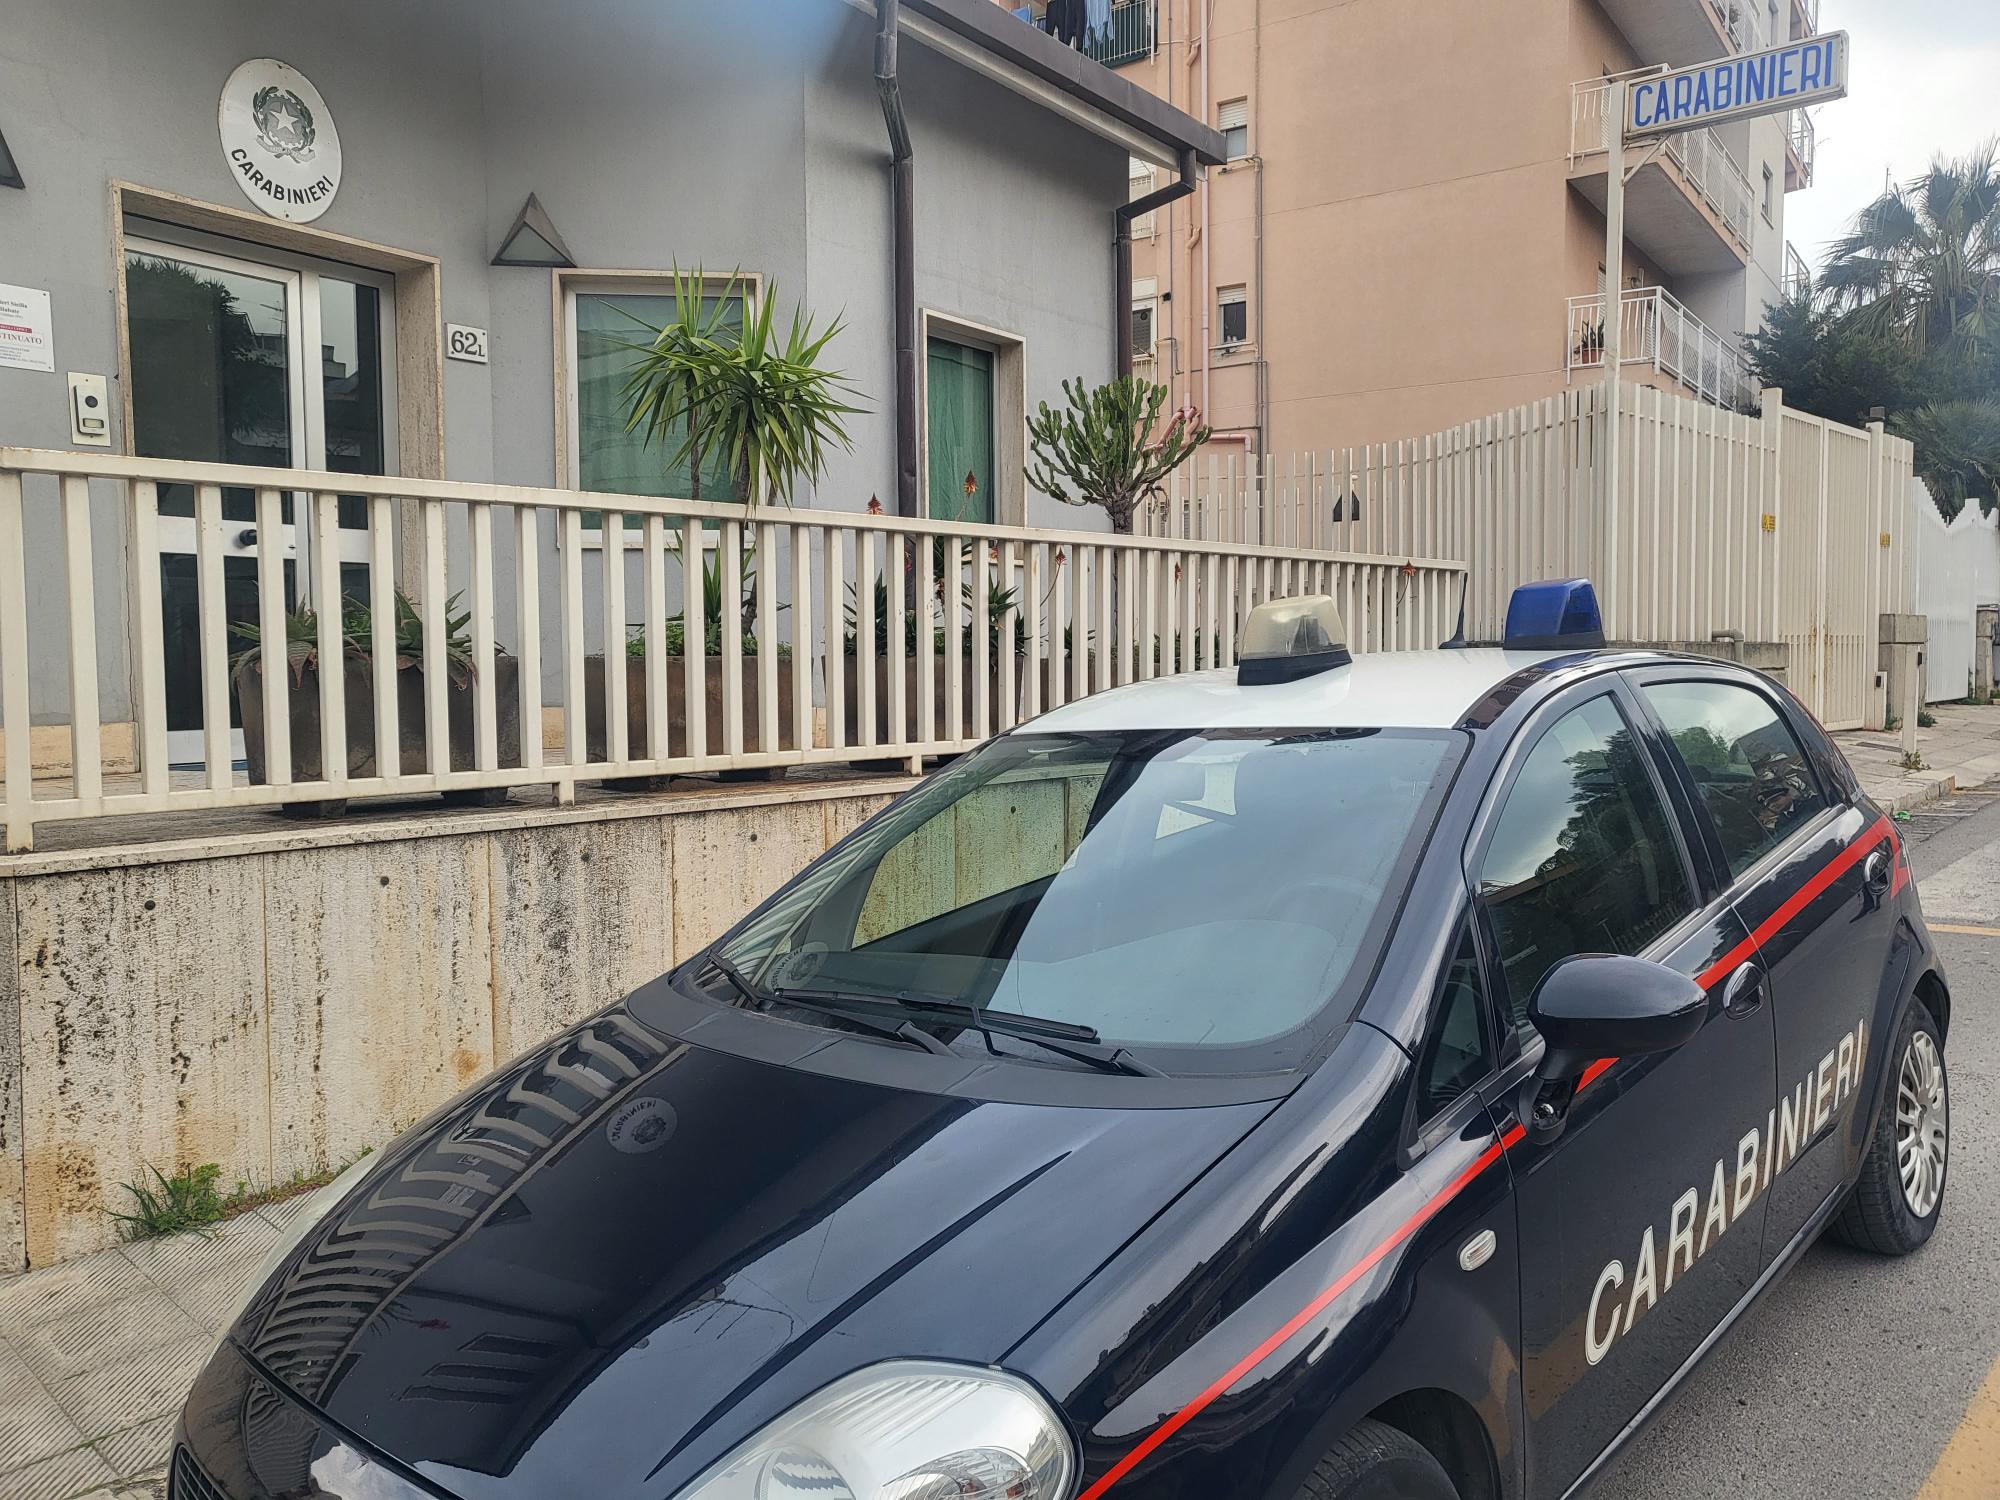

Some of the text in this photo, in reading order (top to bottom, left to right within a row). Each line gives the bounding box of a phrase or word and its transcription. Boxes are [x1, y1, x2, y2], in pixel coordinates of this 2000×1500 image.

[1634, 41, 1833, 127] CARABINIERI
[231, 148, 334, 204] CARABINIERI
[1584, 1018, 1864, 1366] CARABINIERI
